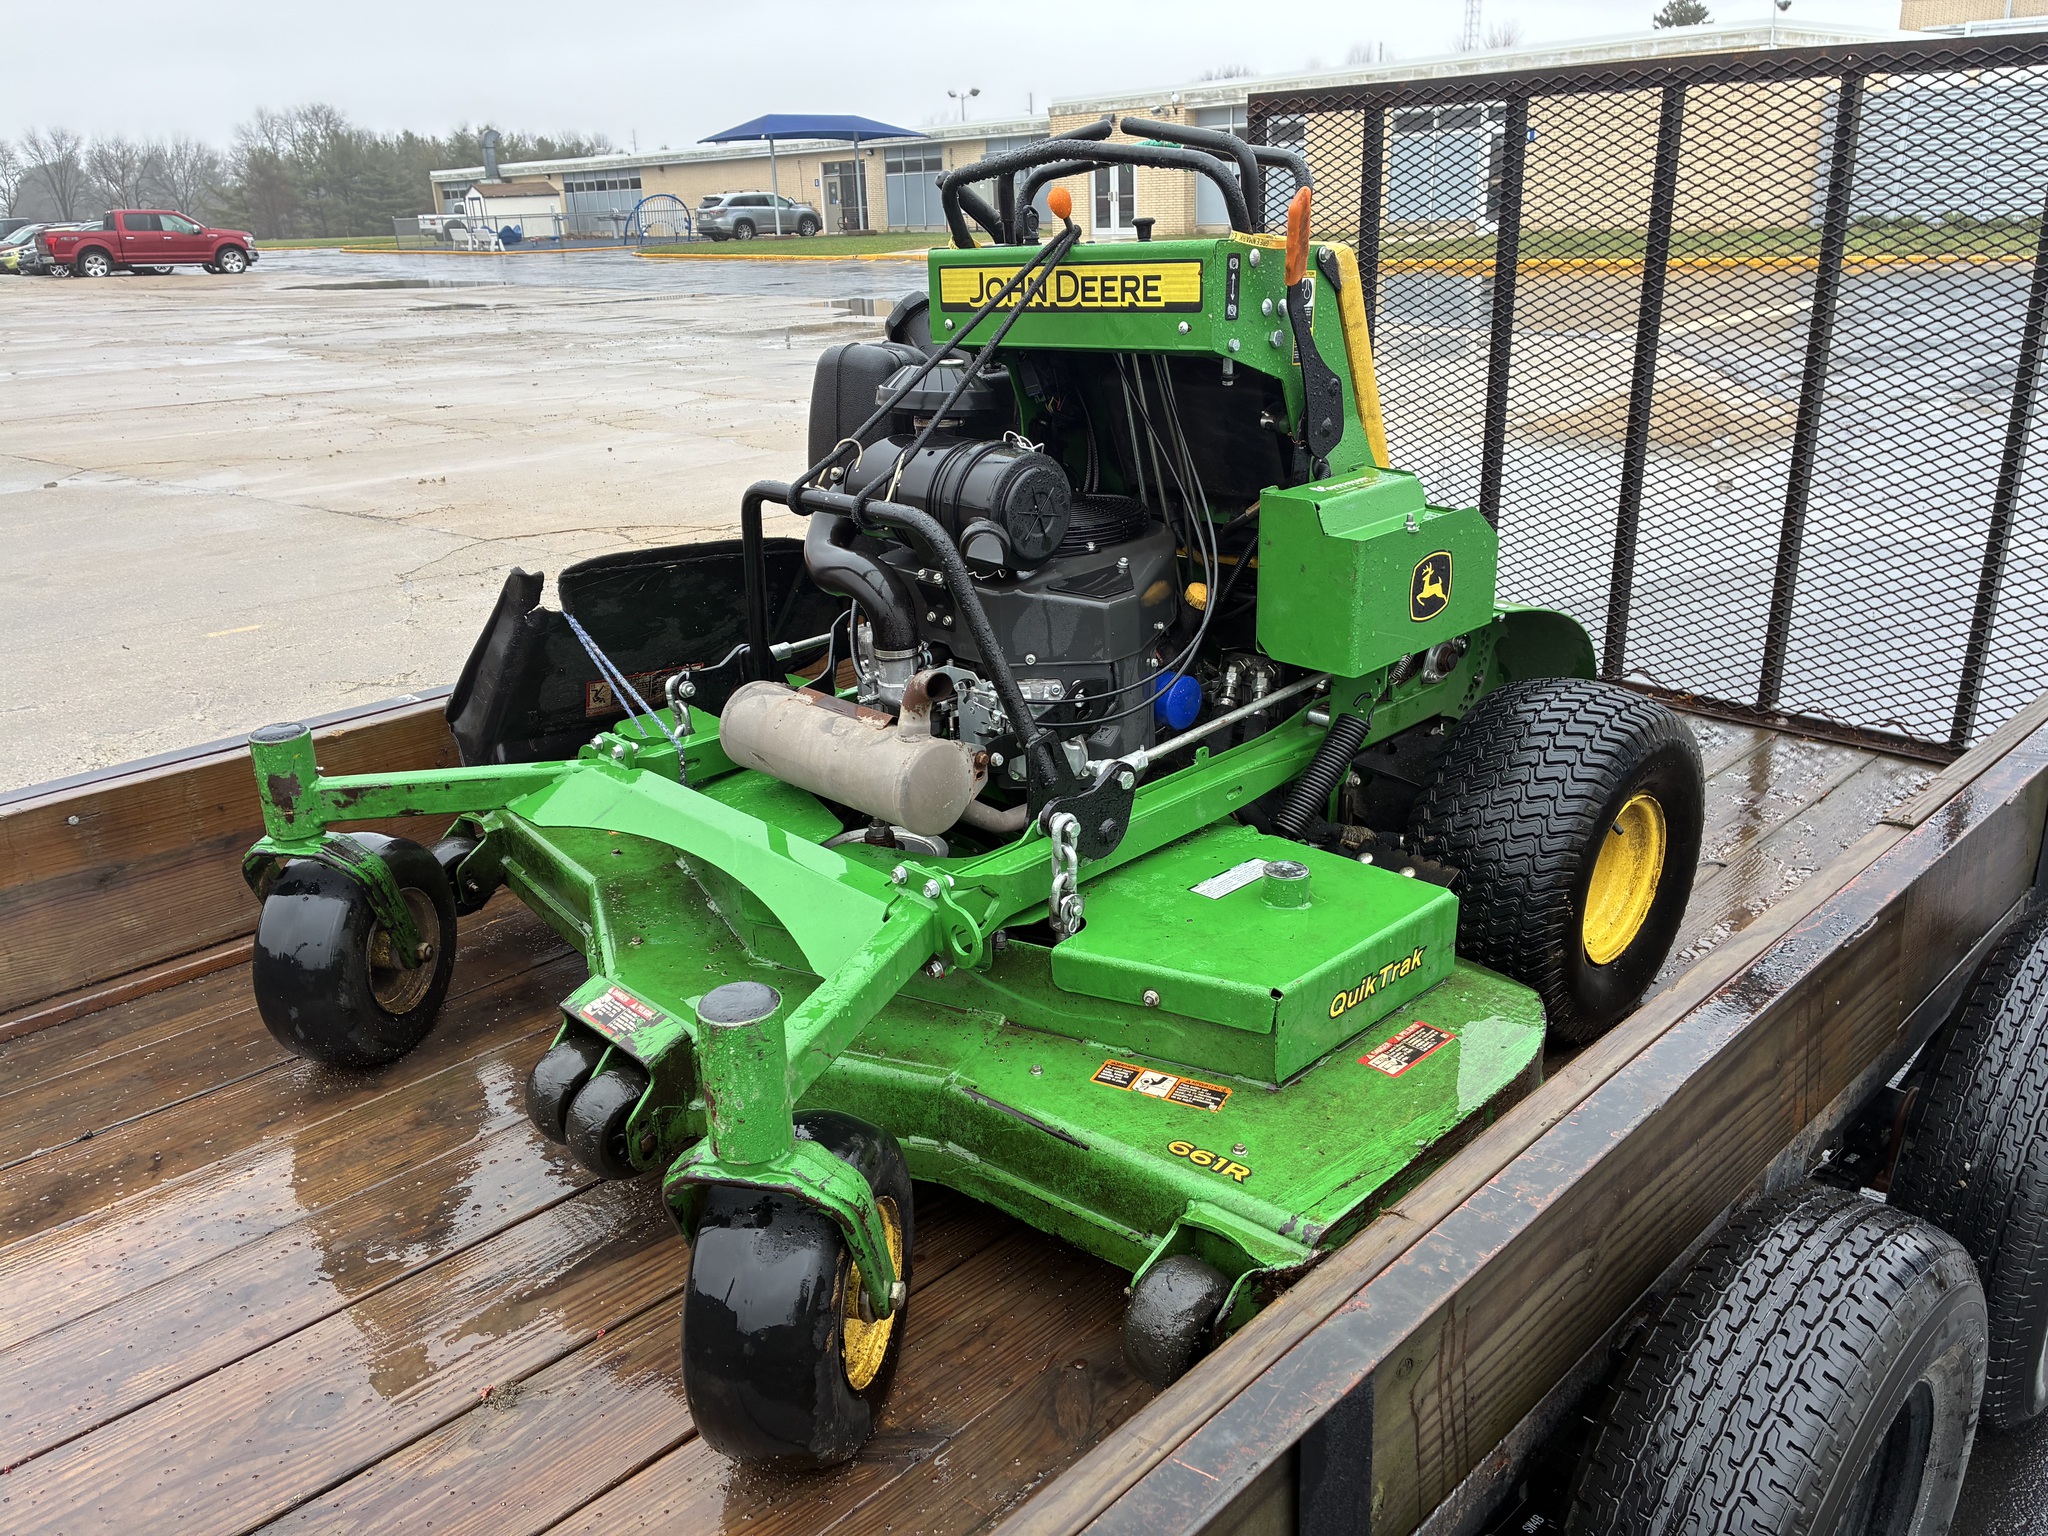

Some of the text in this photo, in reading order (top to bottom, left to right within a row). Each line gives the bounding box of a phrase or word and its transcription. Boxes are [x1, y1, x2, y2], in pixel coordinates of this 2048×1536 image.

[969, 269, 1162, 304] JOHN DEERE
[1329, 946, 1428, 1019] Quik Trak
[1167, 1140, 1252, 1185] 661R
